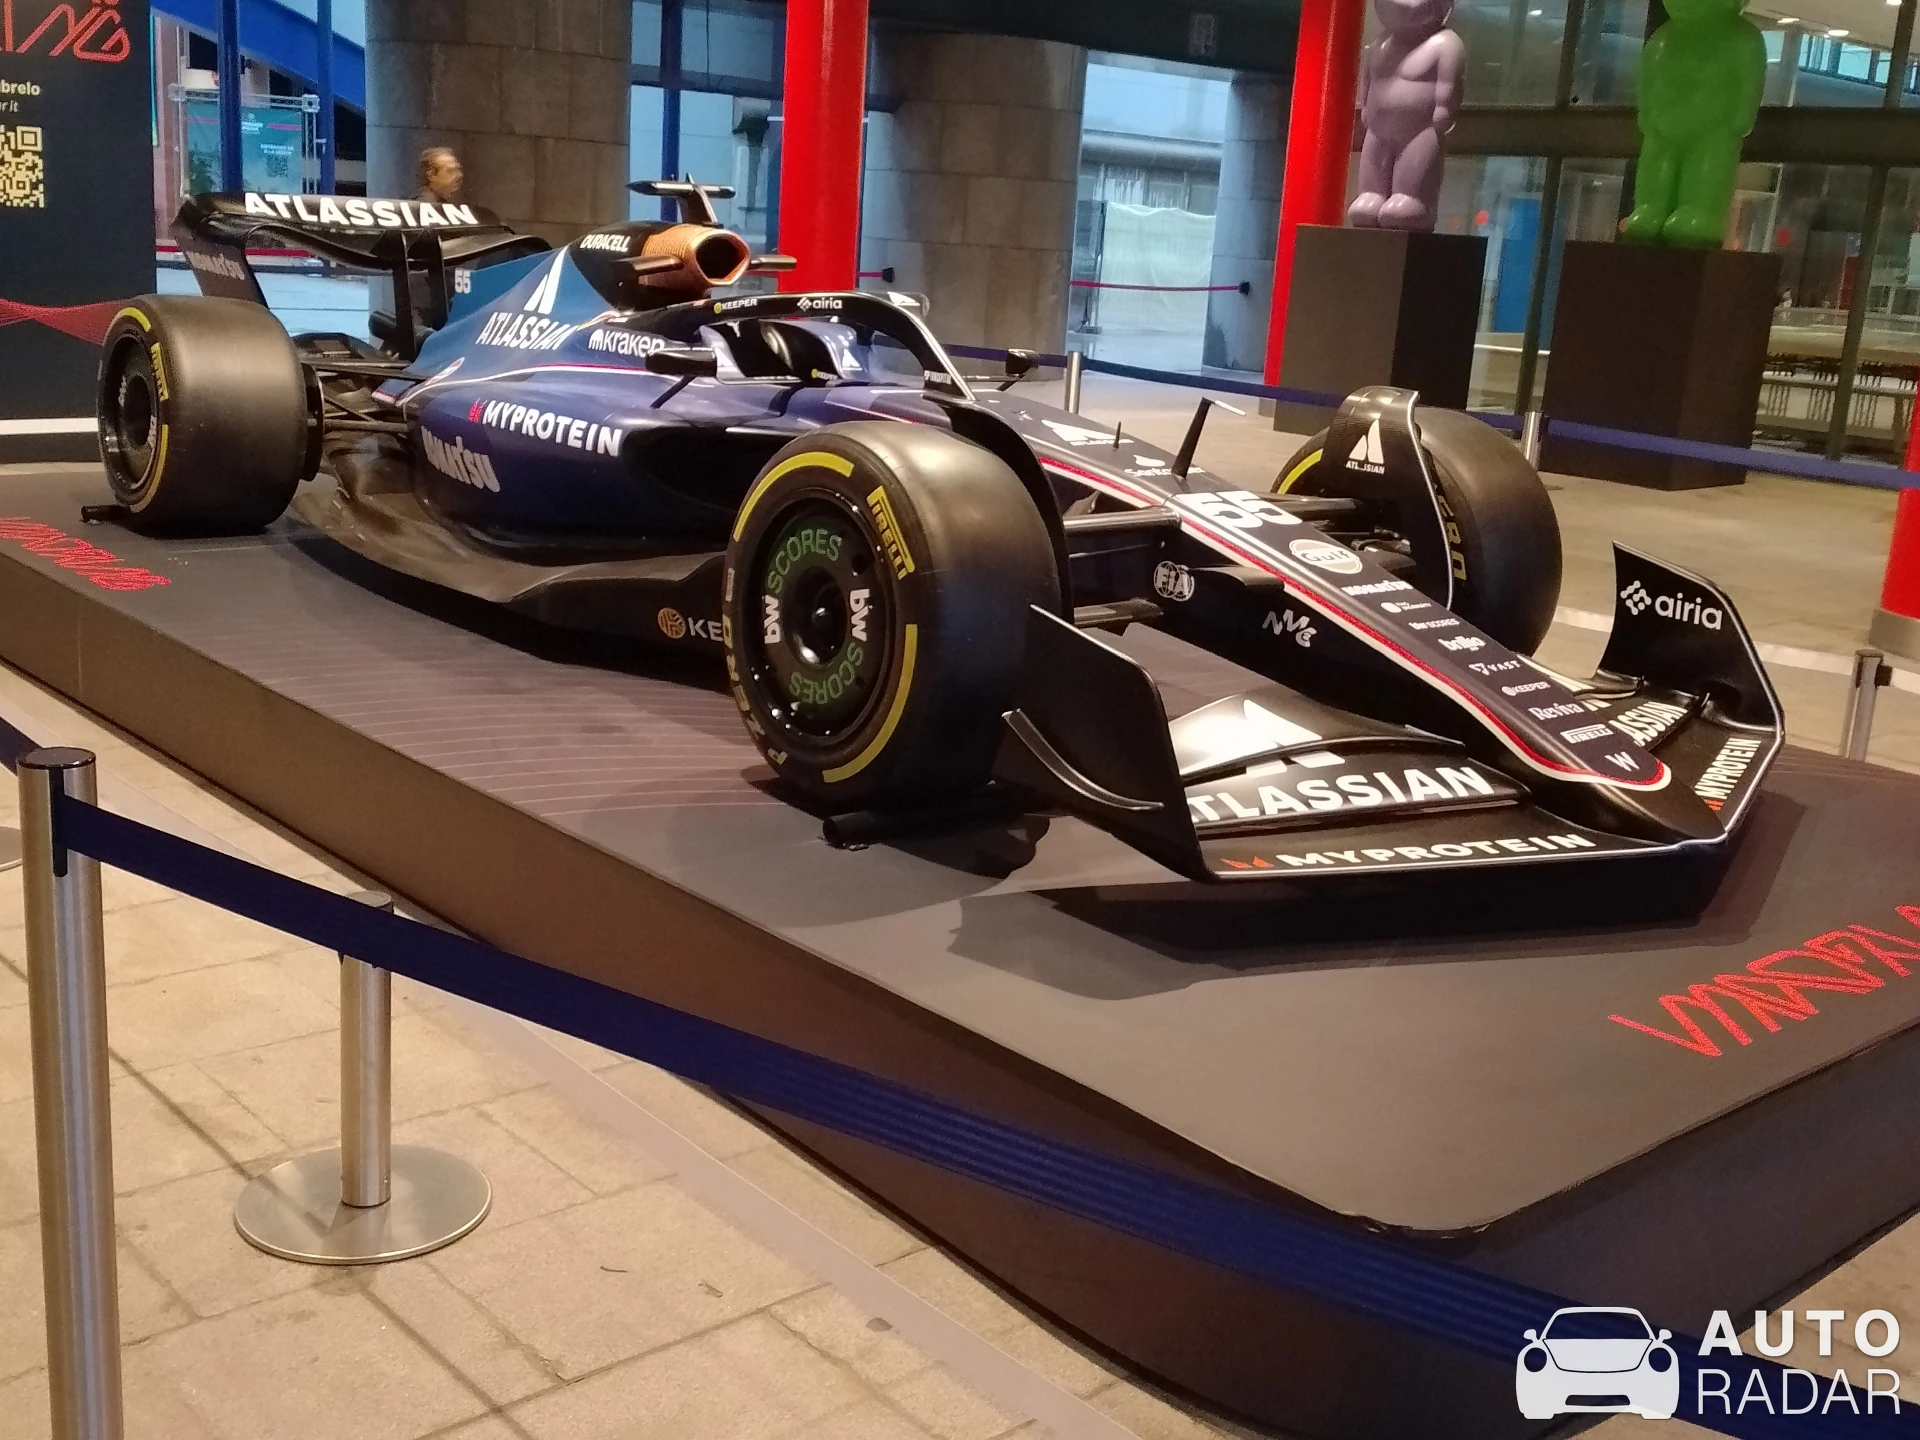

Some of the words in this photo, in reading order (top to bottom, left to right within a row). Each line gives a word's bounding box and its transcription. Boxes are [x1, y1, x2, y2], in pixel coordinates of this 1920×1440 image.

[244, 192, 479, 226] ATLASSIAN
[579, 234, 631, 252] DURACELL
[454, 269, 472, 294] 55
[722, 298, 758, 311] KEEPER
[812, 296, 843, 310] airia
[475, 311, 579, 350] ATLASSIAN
[482, 399, 623, 457] MYPROTEIN
[1173, 490, 1303, 528] 55
[866, 485, 916, 581] PIRELLI
[767, 528, 843, 594] SCORES
[1654, 592, 1723, 630] airia
[687, 616, 724, 643] KE
[788, 641, 864, 704] SCORES
[1487, 660, 1521, 672] VAST
[1512, 681, 1552, 695] KEEPER
[1528, 702, 1585, 721] Reviva
[1608, 701, 1688, 748] ASSIAN
[1559, 723, 1615, 744] PIRELLI
[1694, 737, 1763, 800] MYPROTEIN
[1274, 833, 1598, 868] MYPROTEIN
